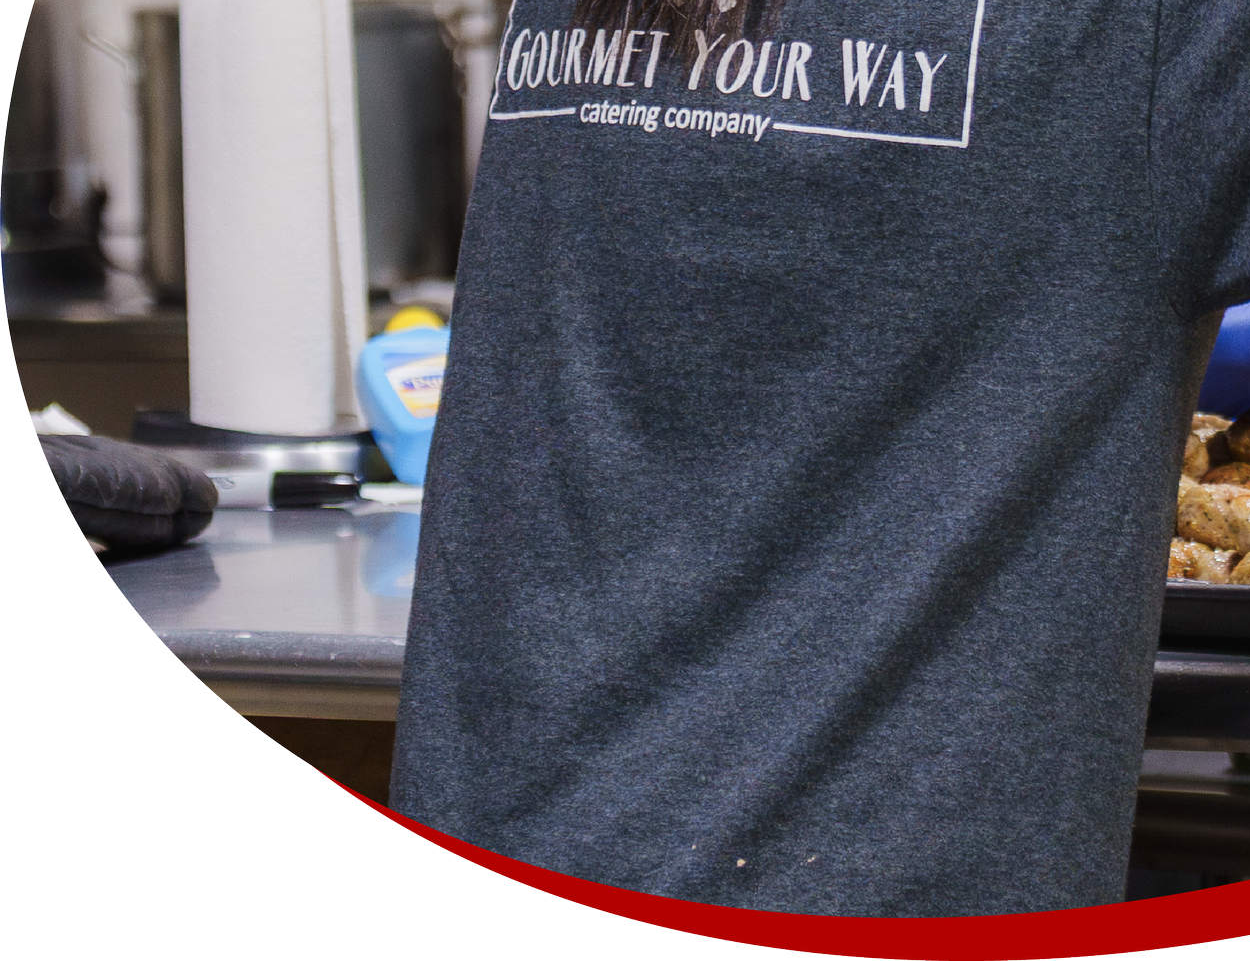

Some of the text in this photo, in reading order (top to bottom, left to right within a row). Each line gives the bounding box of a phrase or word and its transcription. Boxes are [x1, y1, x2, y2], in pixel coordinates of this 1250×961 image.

[507, 28, 948, 112] GOURMET YOUR WAY
[580, 100, 771, 141] catering company
